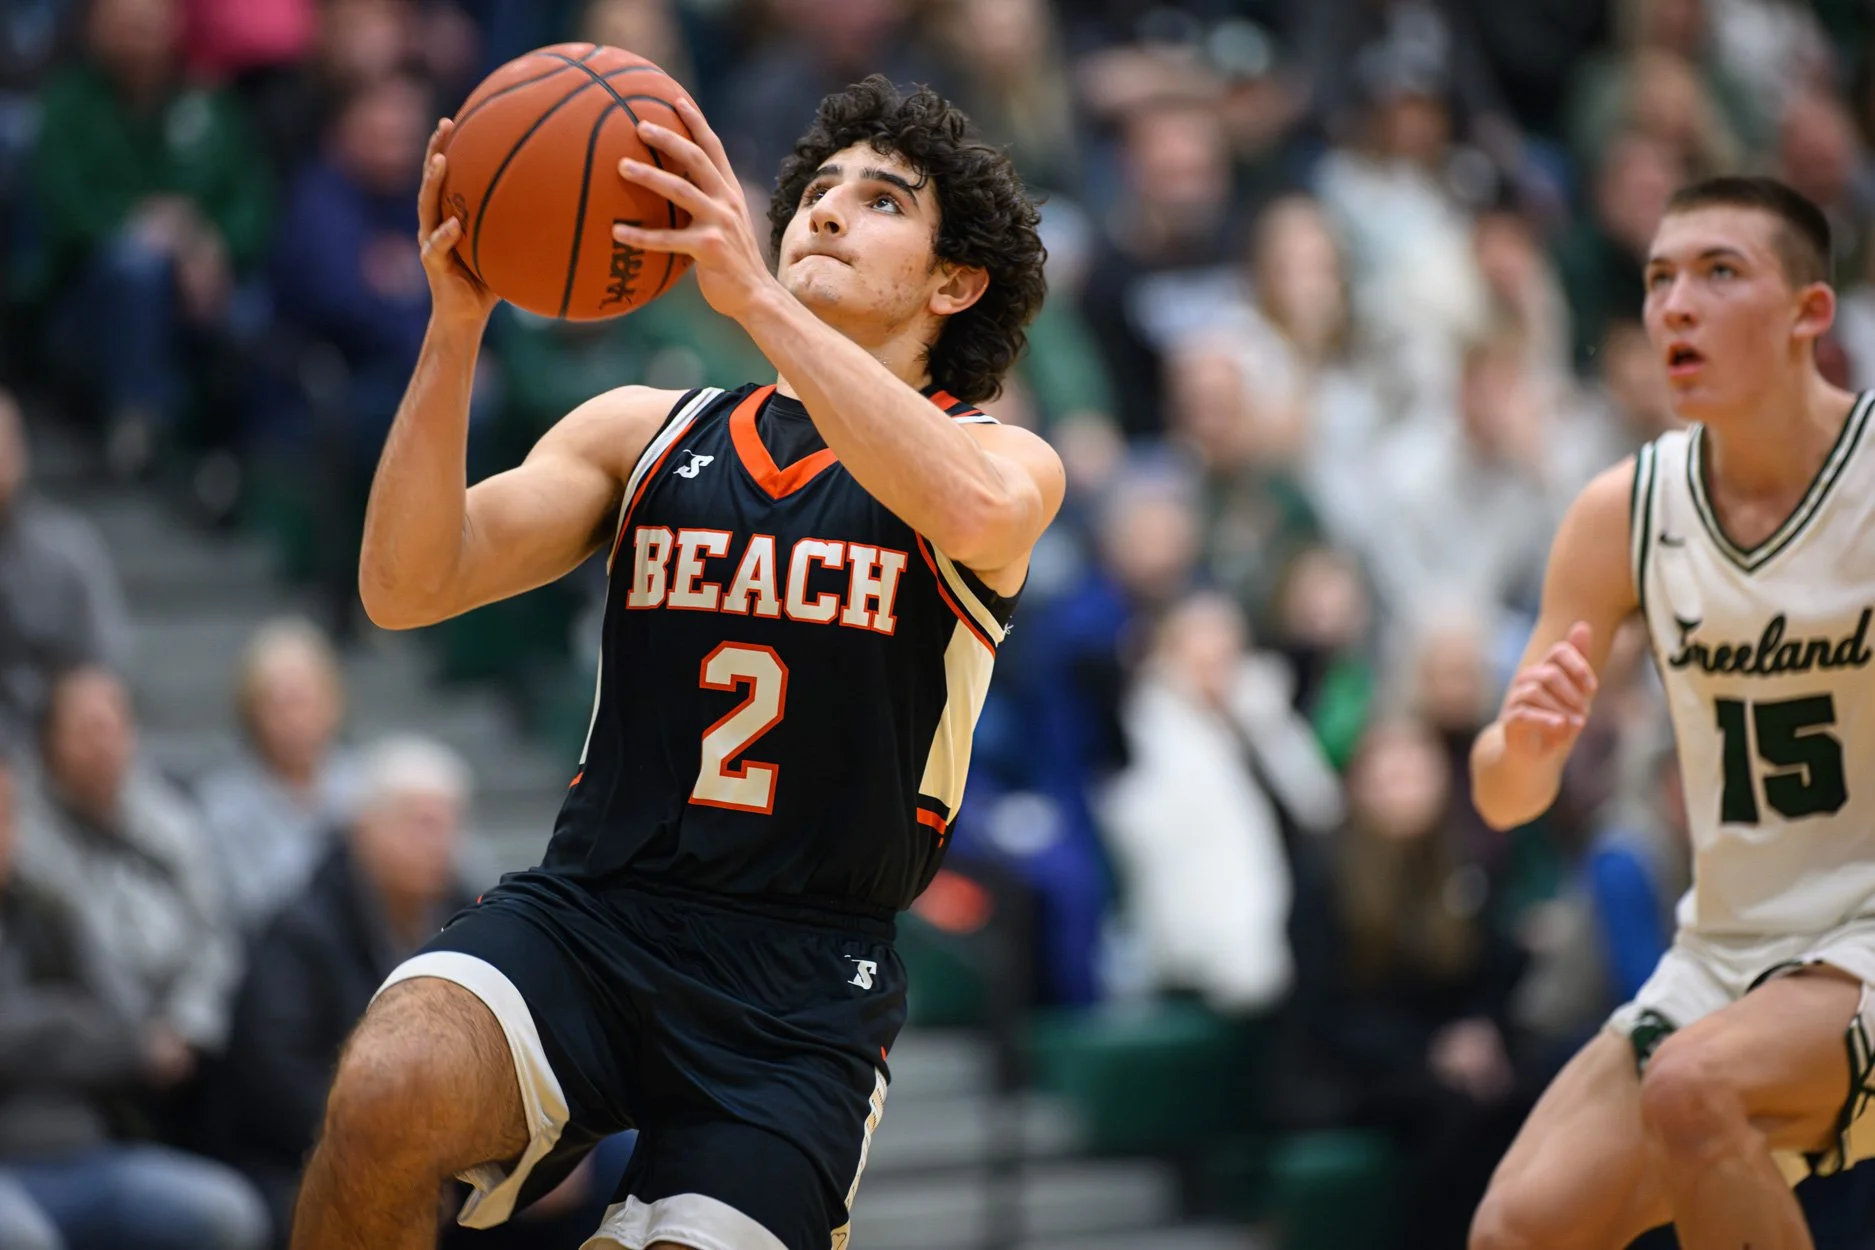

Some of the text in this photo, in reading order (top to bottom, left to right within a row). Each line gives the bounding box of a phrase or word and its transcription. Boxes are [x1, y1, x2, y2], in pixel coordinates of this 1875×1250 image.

[626, 526, 908, 636] BEACH
[1669, 607, 1873, 677] Freeland
[688, 640, 789, 815] 2
[1714, 691, 1849, 827] 15
